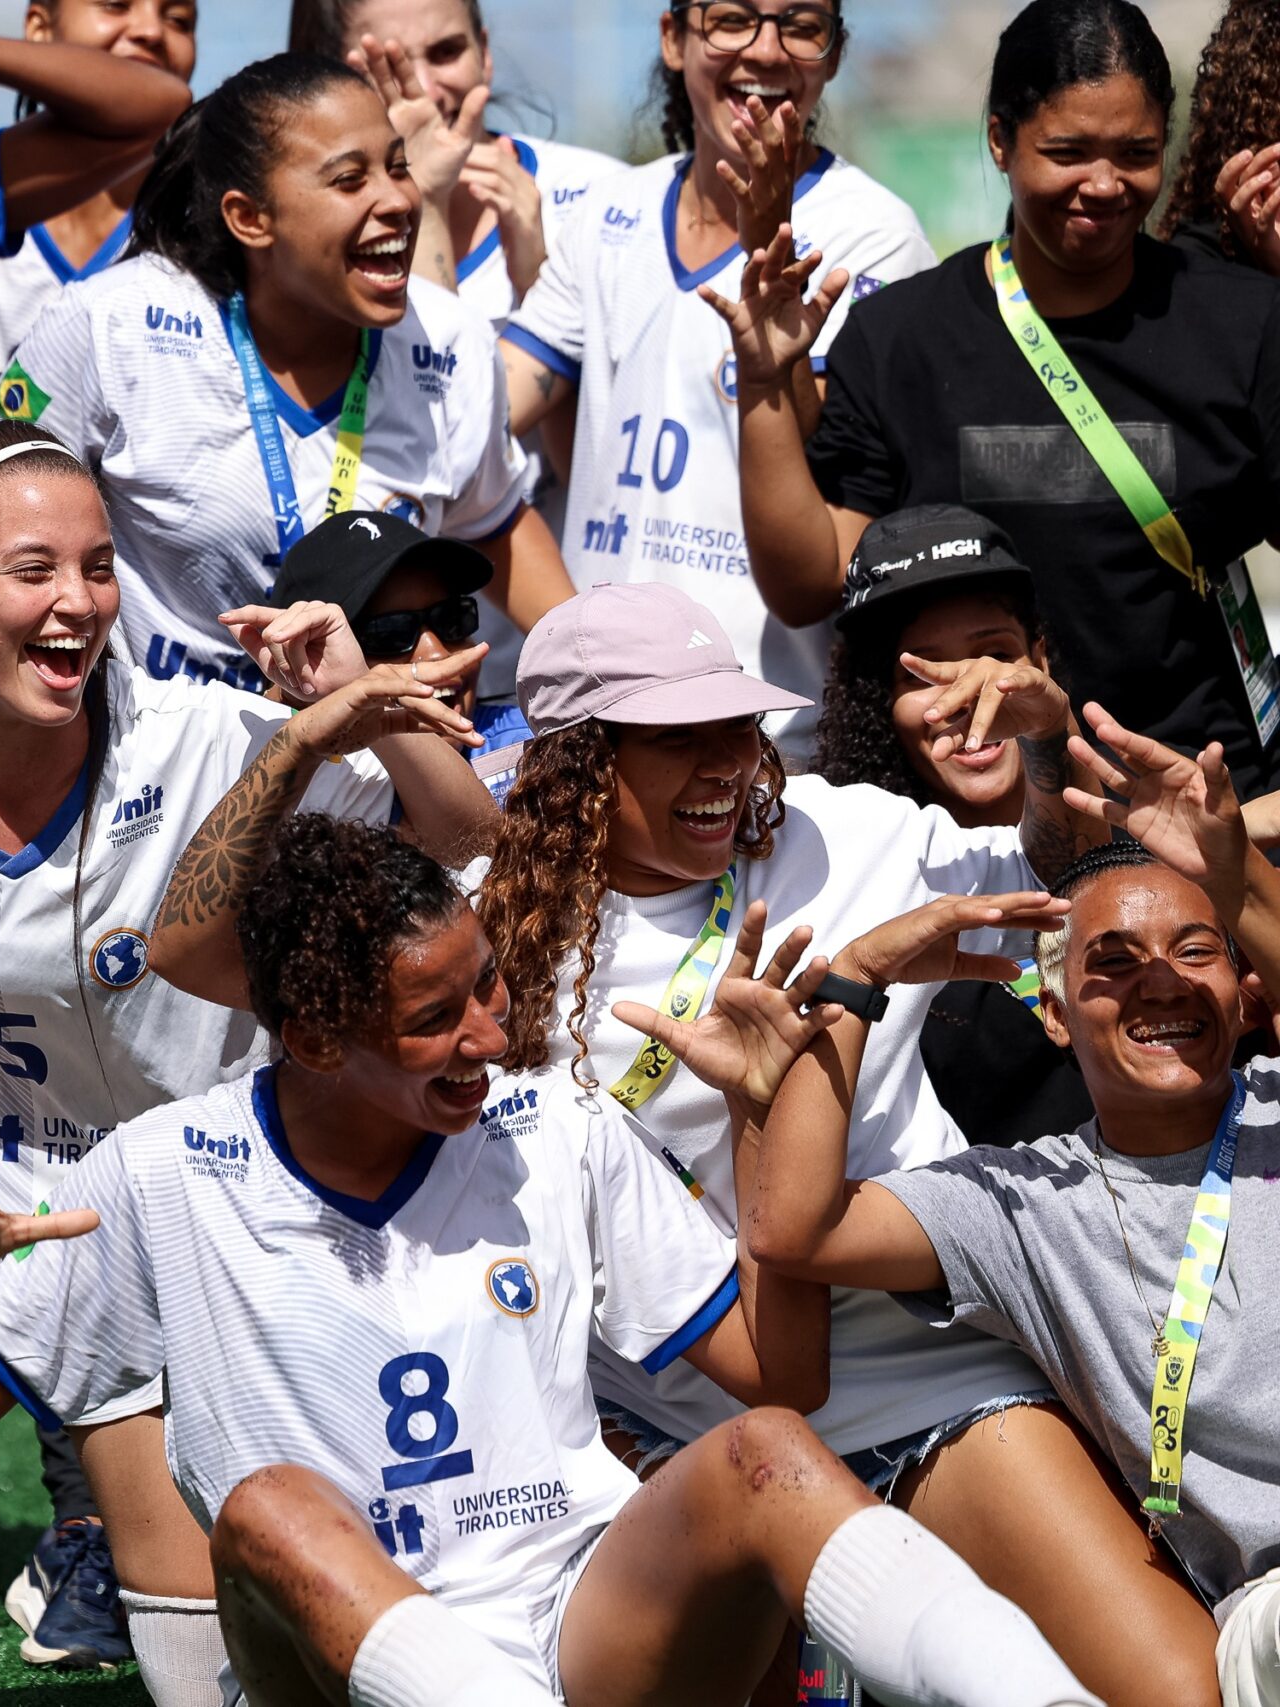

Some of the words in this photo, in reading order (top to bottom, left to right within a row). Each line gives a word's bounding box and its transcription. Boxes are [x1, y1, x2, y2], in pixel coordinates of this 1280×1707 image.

[145, 305, 203, 338] Unit
[617, 414, 689, 493] 10
[583, 504, 628, 555] nit
[643, 518, 748, 551] UNIVERSIDA
[871, 558, 913, 580] Disney
[931, 539, 982, 560] HIGH
[106, 812, 164, 840] UNIVERSIDADE
[111, 824, 160, 849] TIRADENTES
[183, 1125, 252, 1163] Unit
[1216, 1139, 1237, 1174] JOGOS
[378, 1352, 459, 1459] 8
[453, 1480, 570, 1516] UNIVERSIDA
[369, 1497, 425, 1557] it
[455, 1500, 570, 1538] TIRADENTES
